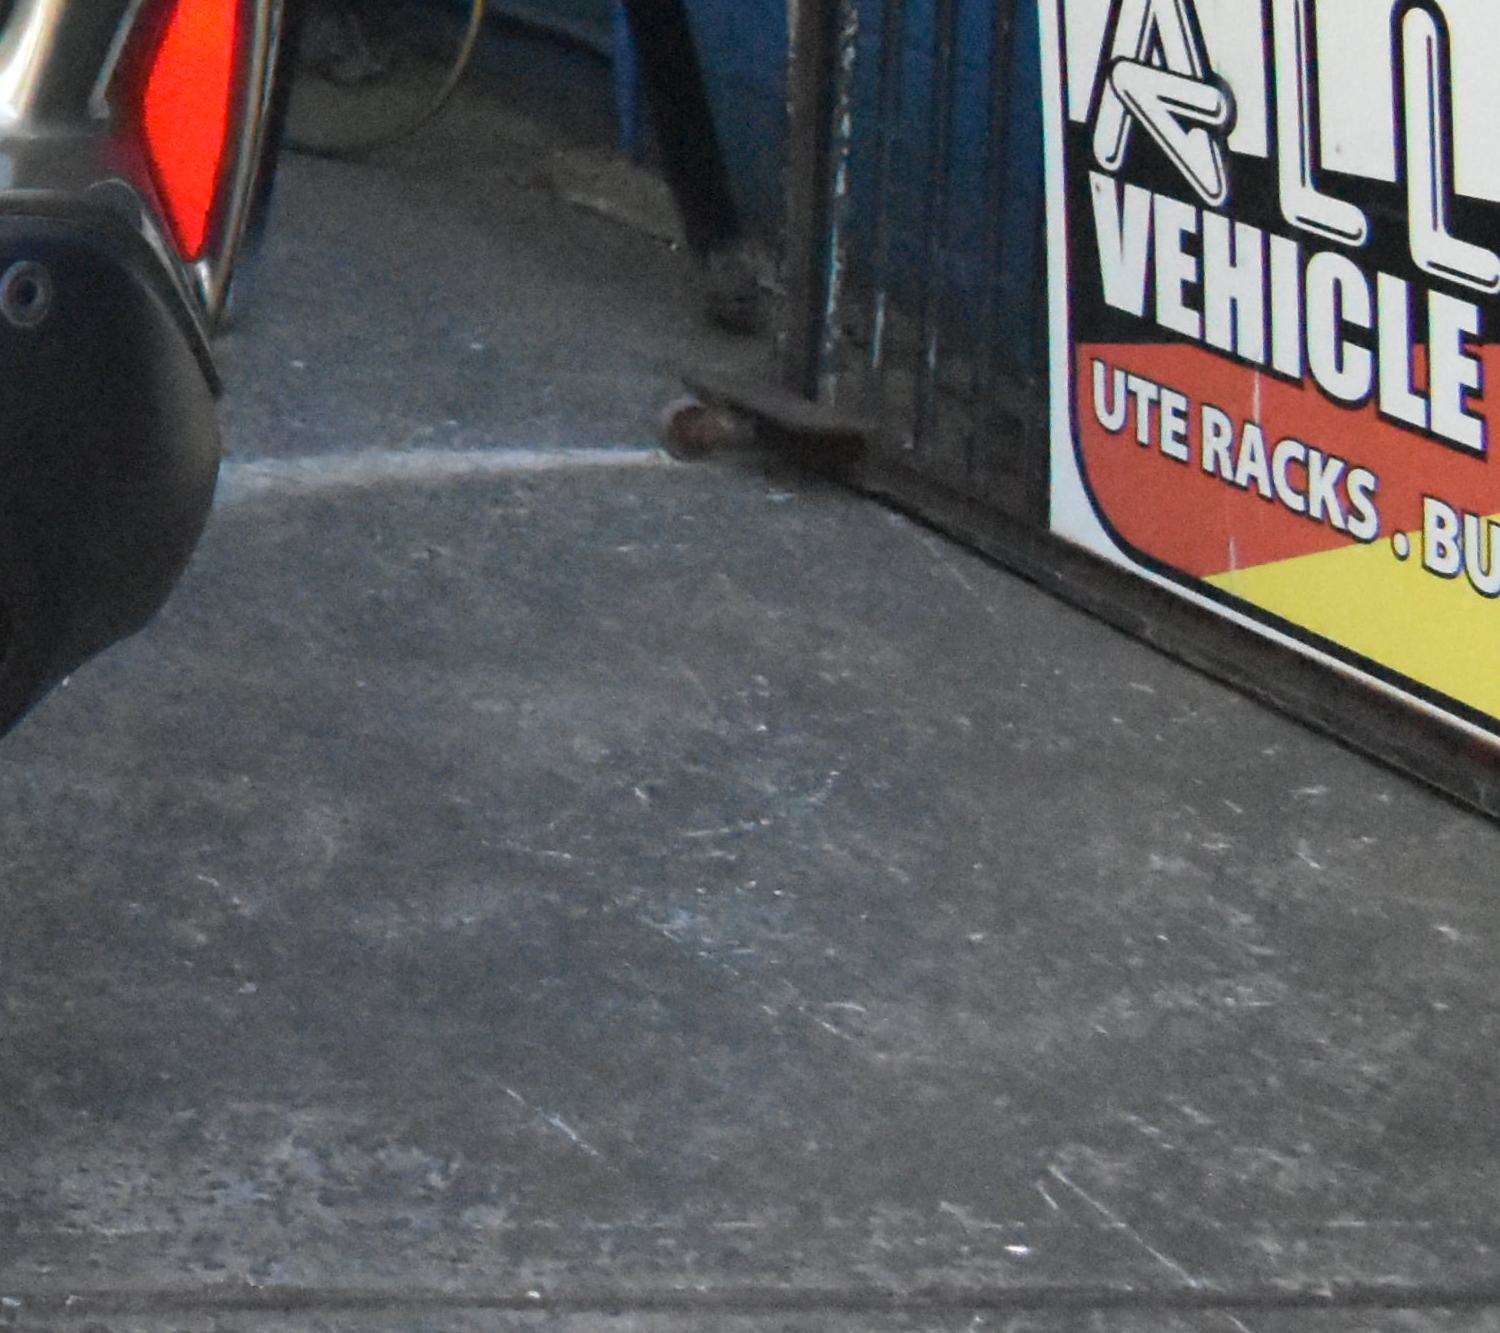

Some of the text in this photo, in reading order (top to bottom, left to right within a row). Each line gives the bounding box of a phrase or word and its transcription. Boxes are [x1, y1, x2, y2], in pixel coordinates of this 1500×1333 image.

[1088, 170, 1488, 455] VEHICLE
[1091, 357, 1190, 465] UTE
[1200, 403, 1380, 544] RACKS
